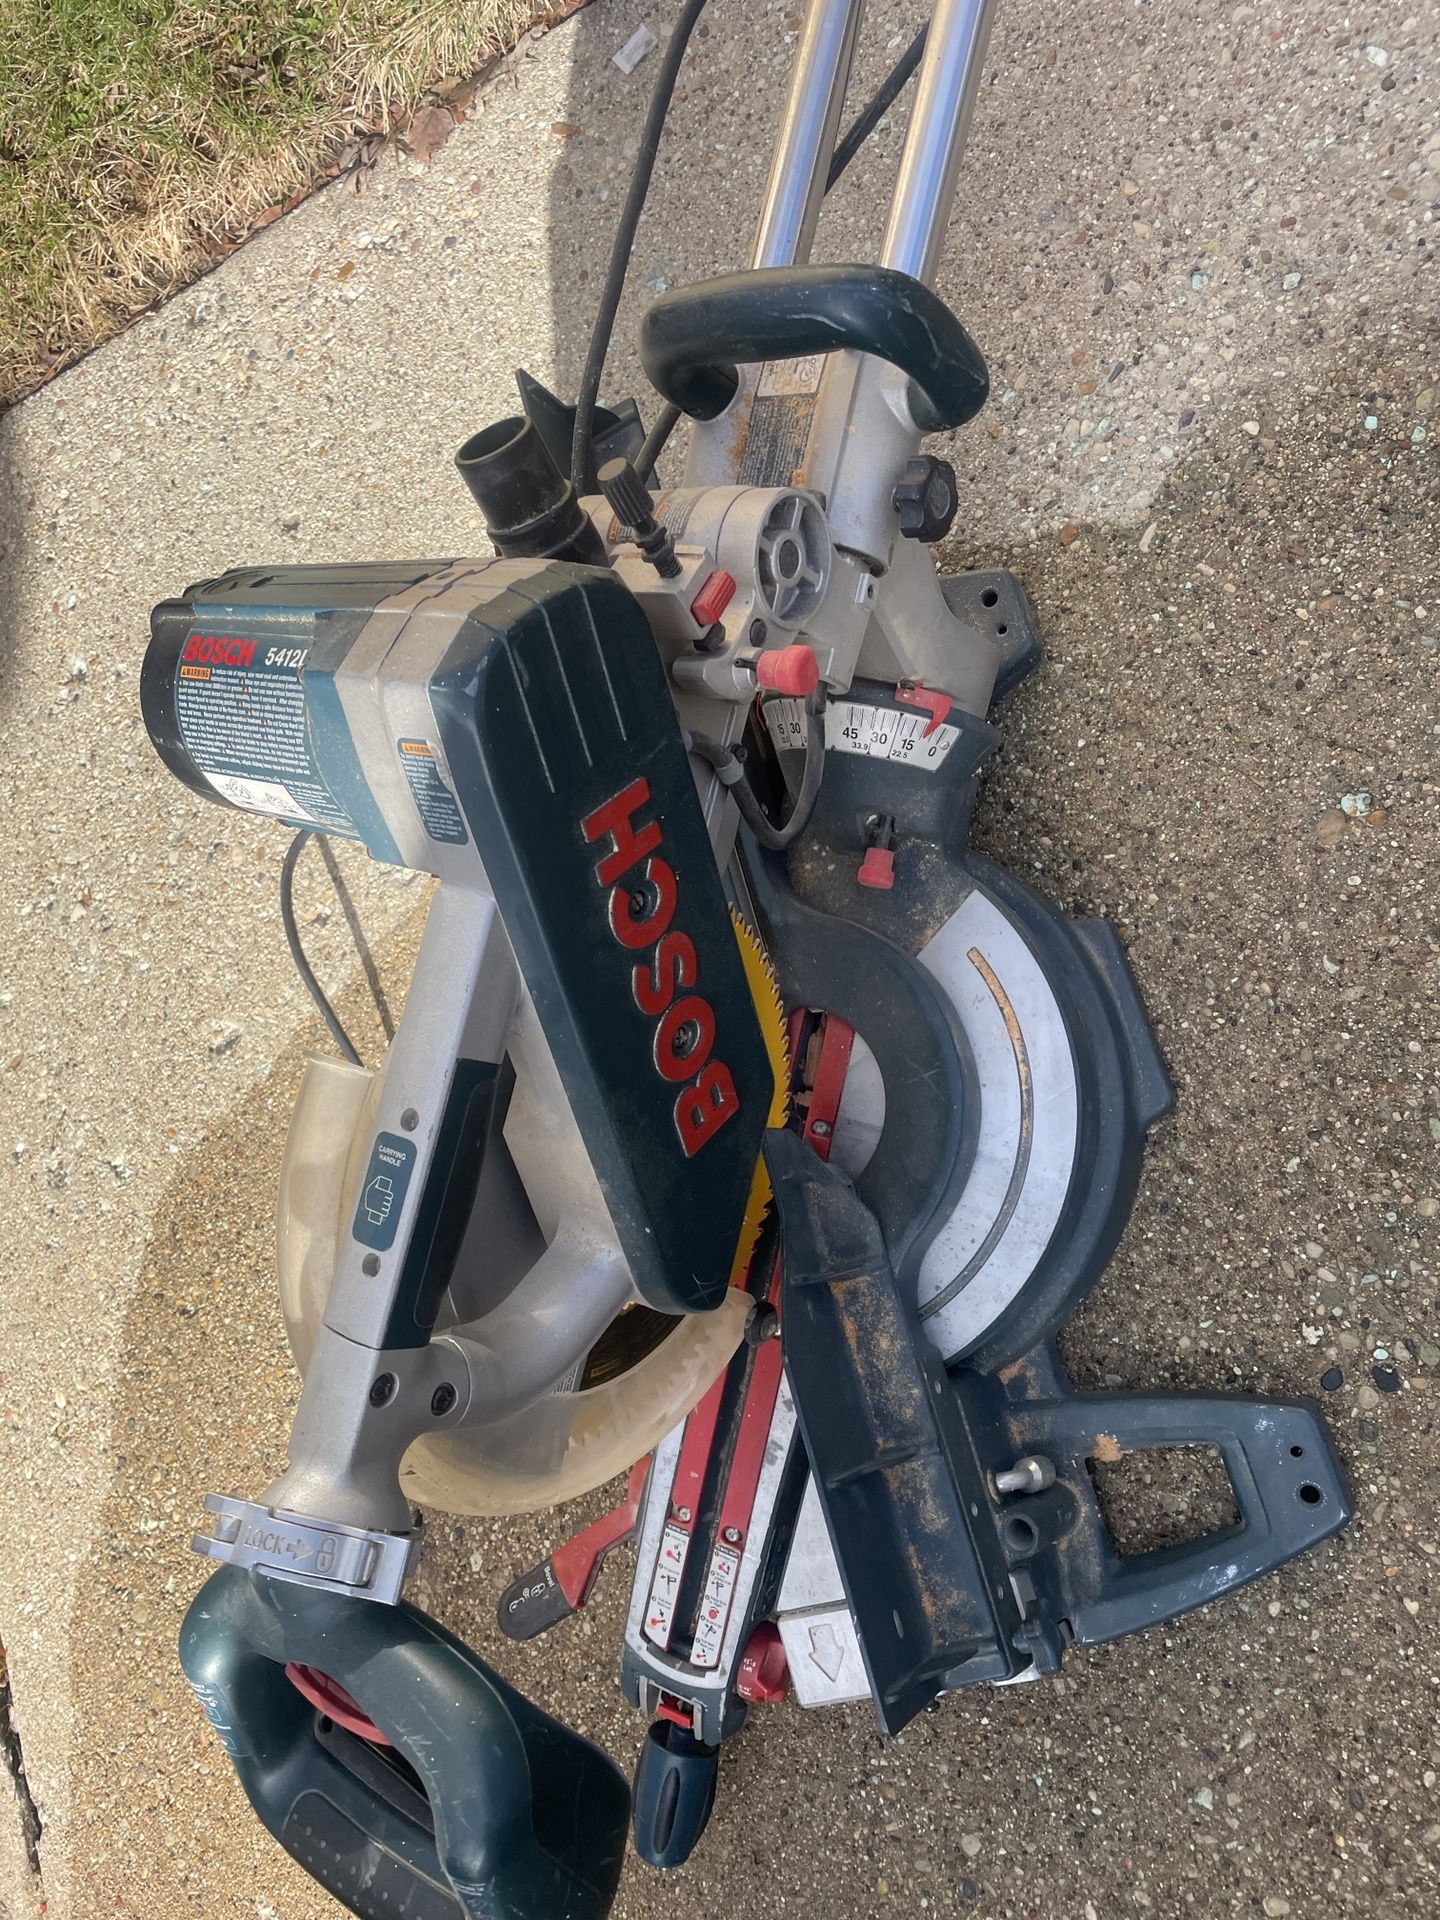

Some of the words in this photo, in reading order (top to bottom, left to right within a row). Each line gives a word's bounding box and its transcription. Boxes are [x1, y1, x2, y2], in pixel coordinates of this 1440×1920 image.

[184, 635, 257, 667] BOSCH
[789, 722, 801, 734] 30
[842, 727, 858, 740] 45
[870, 731, 888, 745] 30
[901, 738, 915, 751] 15
[928, 746, 937, 757] 0
[851, 741, 869, 751] 33.9
[891, 749, 908, 759] 22.5
[579, 776, 740, 1158] BOSCH
[379, 1145, 406, 1160] CARRYING
[379, 1152, 401, 1166] HANDLE
[243, 1526, 286, 1555] LOCK
[544, 1565, 555, 1588] Bevel
